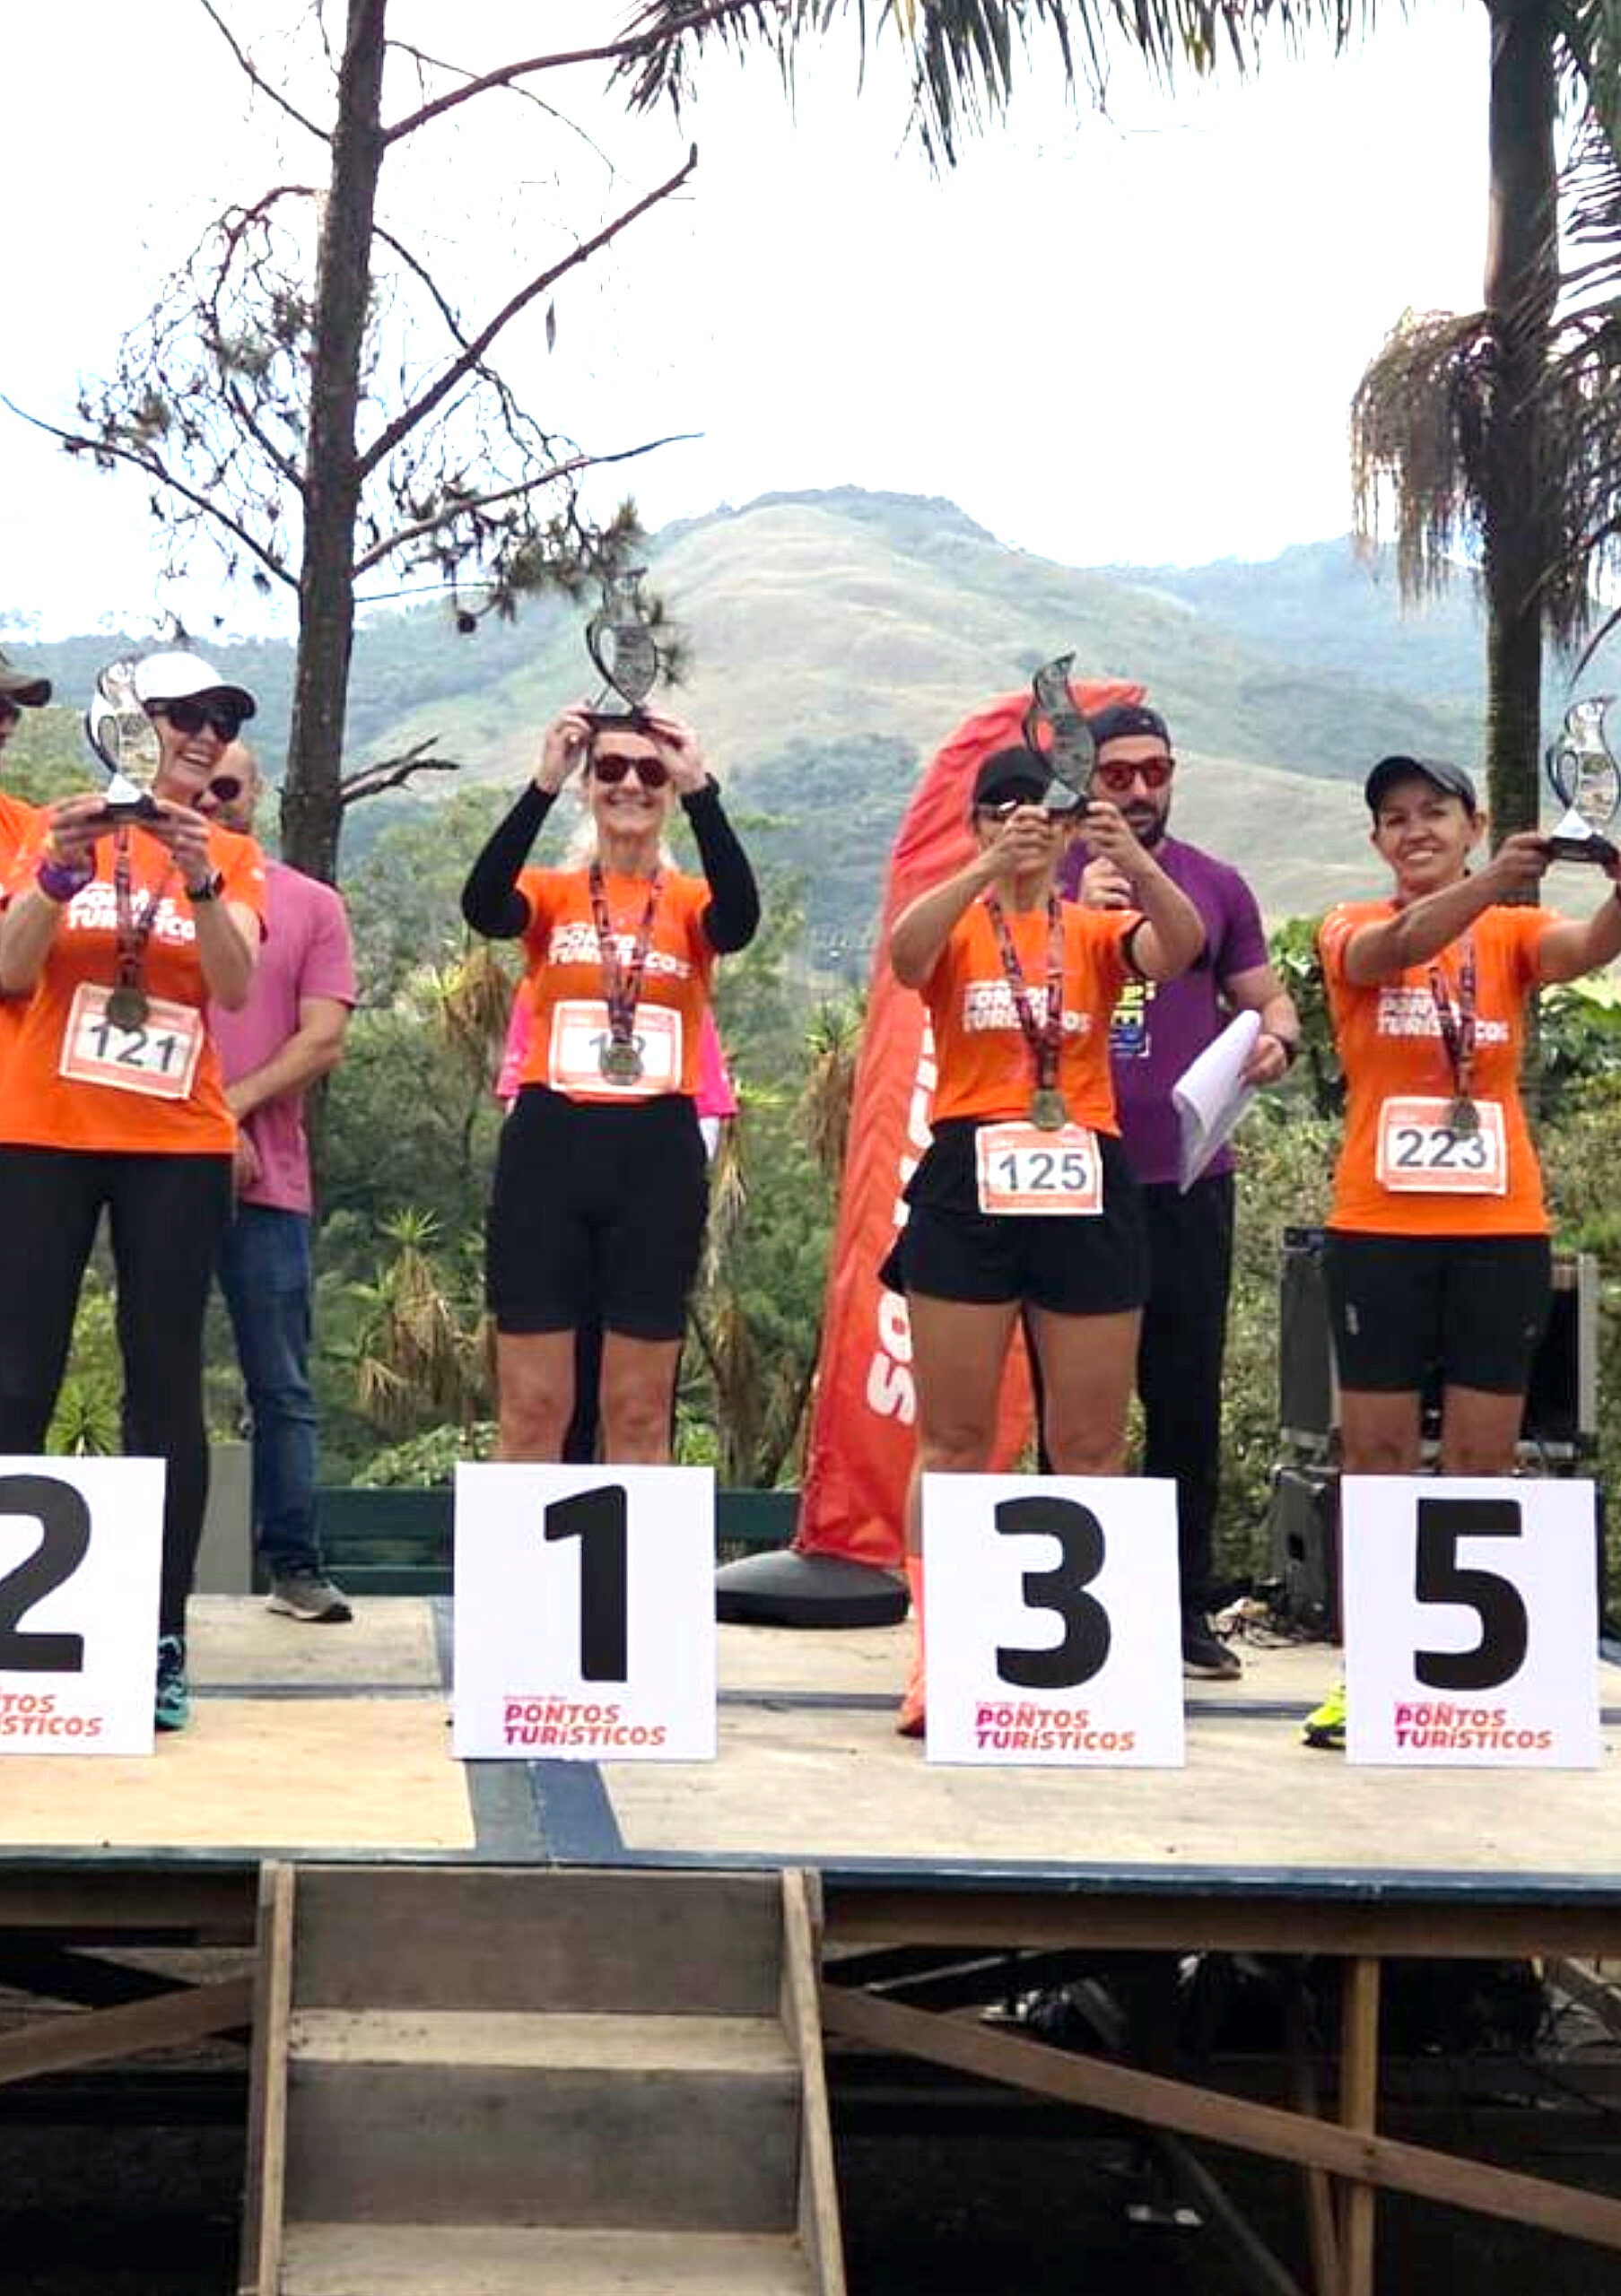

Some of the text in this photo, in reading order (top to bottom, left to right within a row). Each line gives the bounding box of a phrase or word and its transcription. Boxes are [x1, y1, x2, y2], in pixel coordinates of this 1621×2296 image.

[90, 1022, 177, 1072] 121
[1396, 1128, 1488, 1169] 223
[999, 1153, 1087, 1191] 125
[0, 1474, 92, 1673] 2
[544, 1484, 628, 1683] 1
[994, 1496, 1111, 1690] 3
[1414, 1497, 1529, 1692] 5
[504, 1703, 621, 1724] PONTOS
[975, 1708, 1089, 1727] PONTOS
[1395, 1707, 1507, 1726] PONTOS
[504, 1724, 667, 1746] TURÍSTICOS
[975, 1728, 1136, 1751] TURÍSTICOS
[1396, 1726, 1552, 1749] TURÍSTICOS
